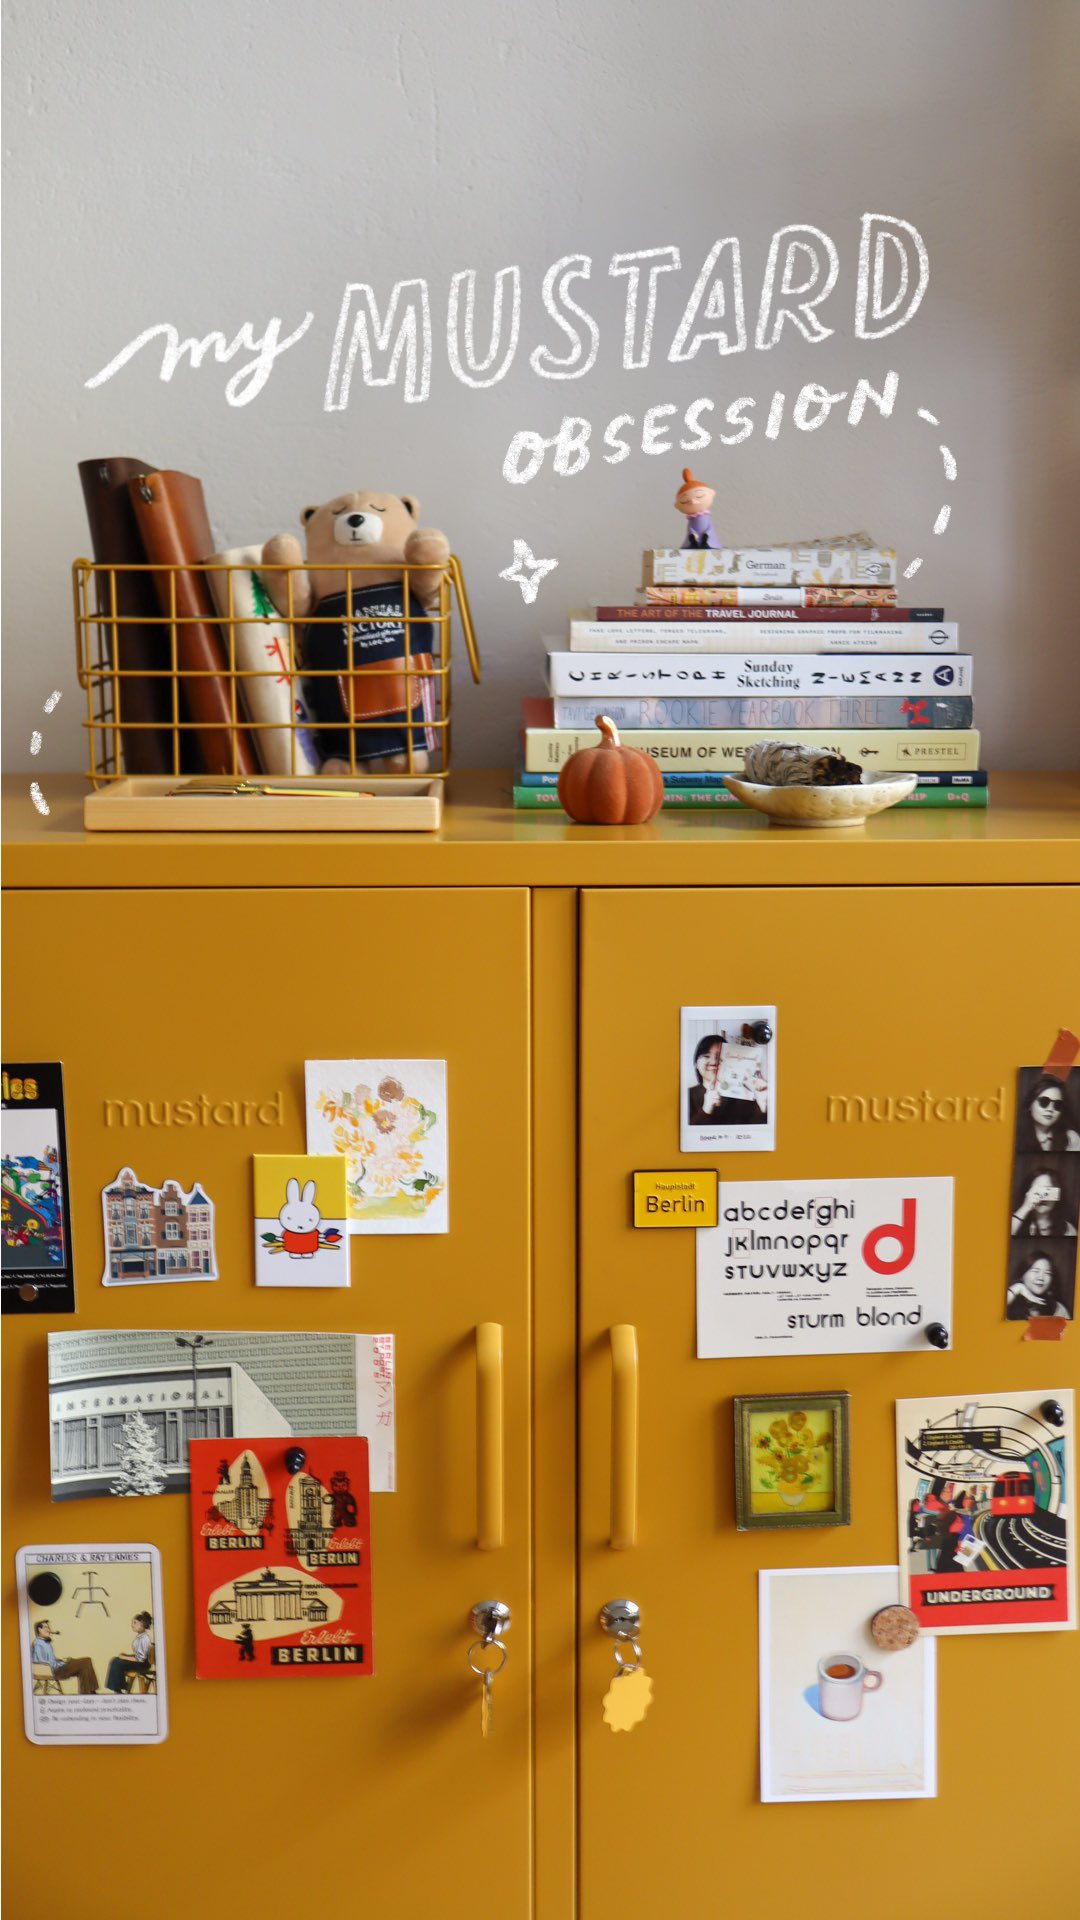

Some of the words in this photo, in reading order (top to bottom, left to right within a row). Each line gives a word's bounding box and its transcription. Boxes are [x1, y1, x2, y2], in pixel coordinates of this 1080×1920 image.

[746, 560, 787, 569] German
[617, 609, 638, 618] THE
[641, 609, 661, 618] ART
[664, 609, 678, 618] OF
[682, 609, 702, 618] THE
[705, 609, 746, 618] TRAVEL
[748, 609, 799, 619] JOURNAL
[744, 660, 794, 674] Sunday
[737, 675, 800, 690] Sketching
[640, 700, 719, 725] ROOKIE
[728, 700, 816, 725] YEARBOOK
[824, 700, 886, 724] THREE
[640, 746, 691, 758] SEUM
[696, 746, 717, 758] OF
[691, 793, 712, 802] THE
[103, 1092, 285, 1127] mustard
[827, 1088, 1006, 1124] mustard
[646, 1195, 705, 1213] Berlin
[723, 1198, 856, 1227] abcdefghi
[724, 1230, 849, 1257] jklmnopqr
[856, 1305, 922, 1328] blond
[56, 1390, 224, 1412] INTERNATIONAL
[209, 1537, 262, 1549] BERLIN
[36, 1554, 77, 1562] CHARLES
[80, 1554, 87, 1562] &
[90, 1554, 105, 1562] RAY
[108, 1553, 139, 1561] EAMES
[309, 1552, 358, 1565] BERLIN
[926, 1586, 1052, 1604] UNDERGROUND
[278, 1648, 357, 1663] BERLIN
